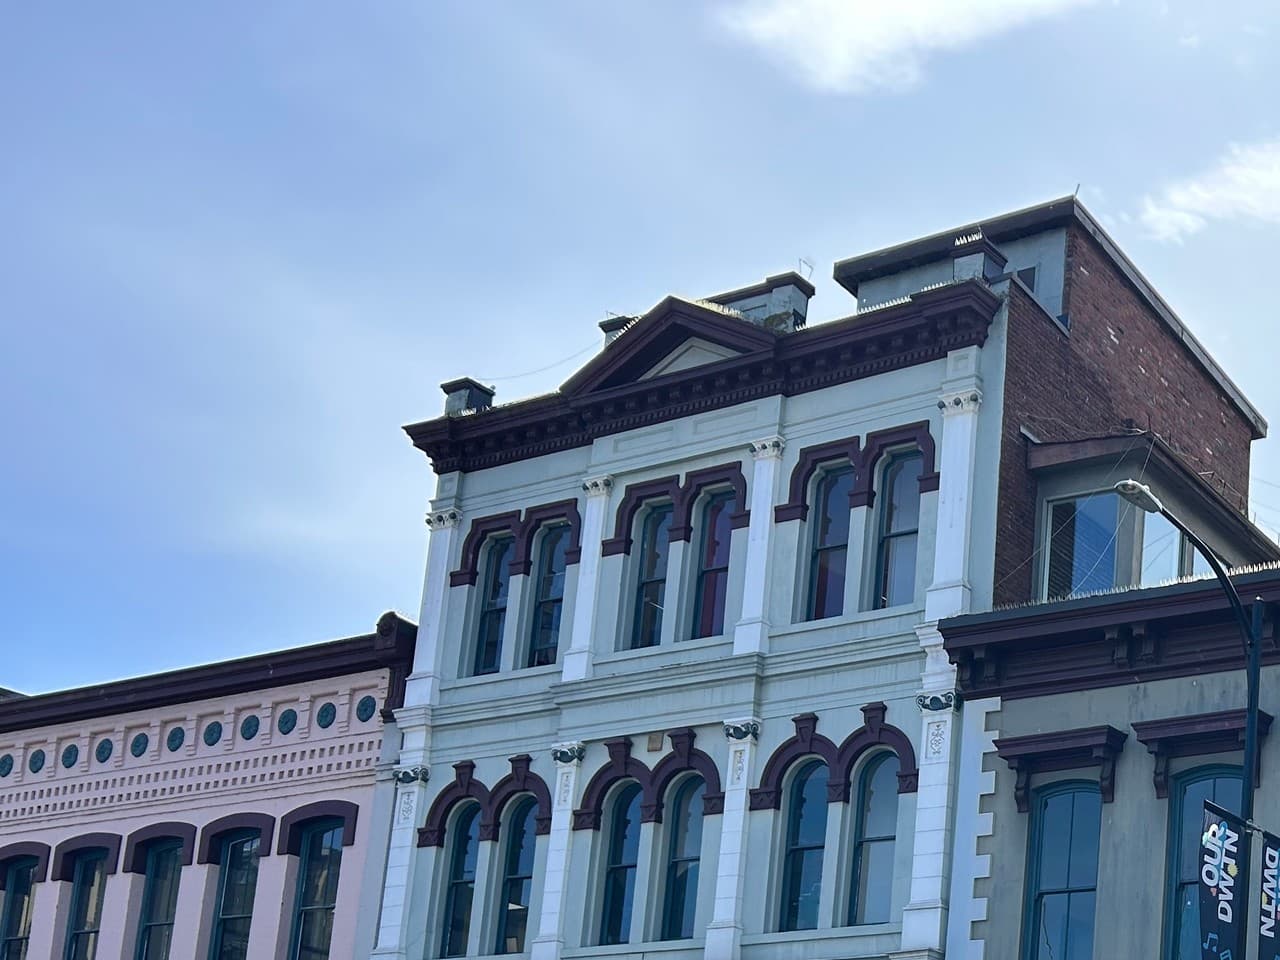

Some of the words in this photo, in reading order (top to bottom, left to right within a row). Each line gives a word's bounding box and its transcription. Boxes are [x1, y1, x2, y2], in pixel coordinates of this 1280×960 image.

[1201, 823, 1222, 887] OUR
[1218, 829, 1239, 923] DWTN
[1260, 846, 1280, 938] DWTN
